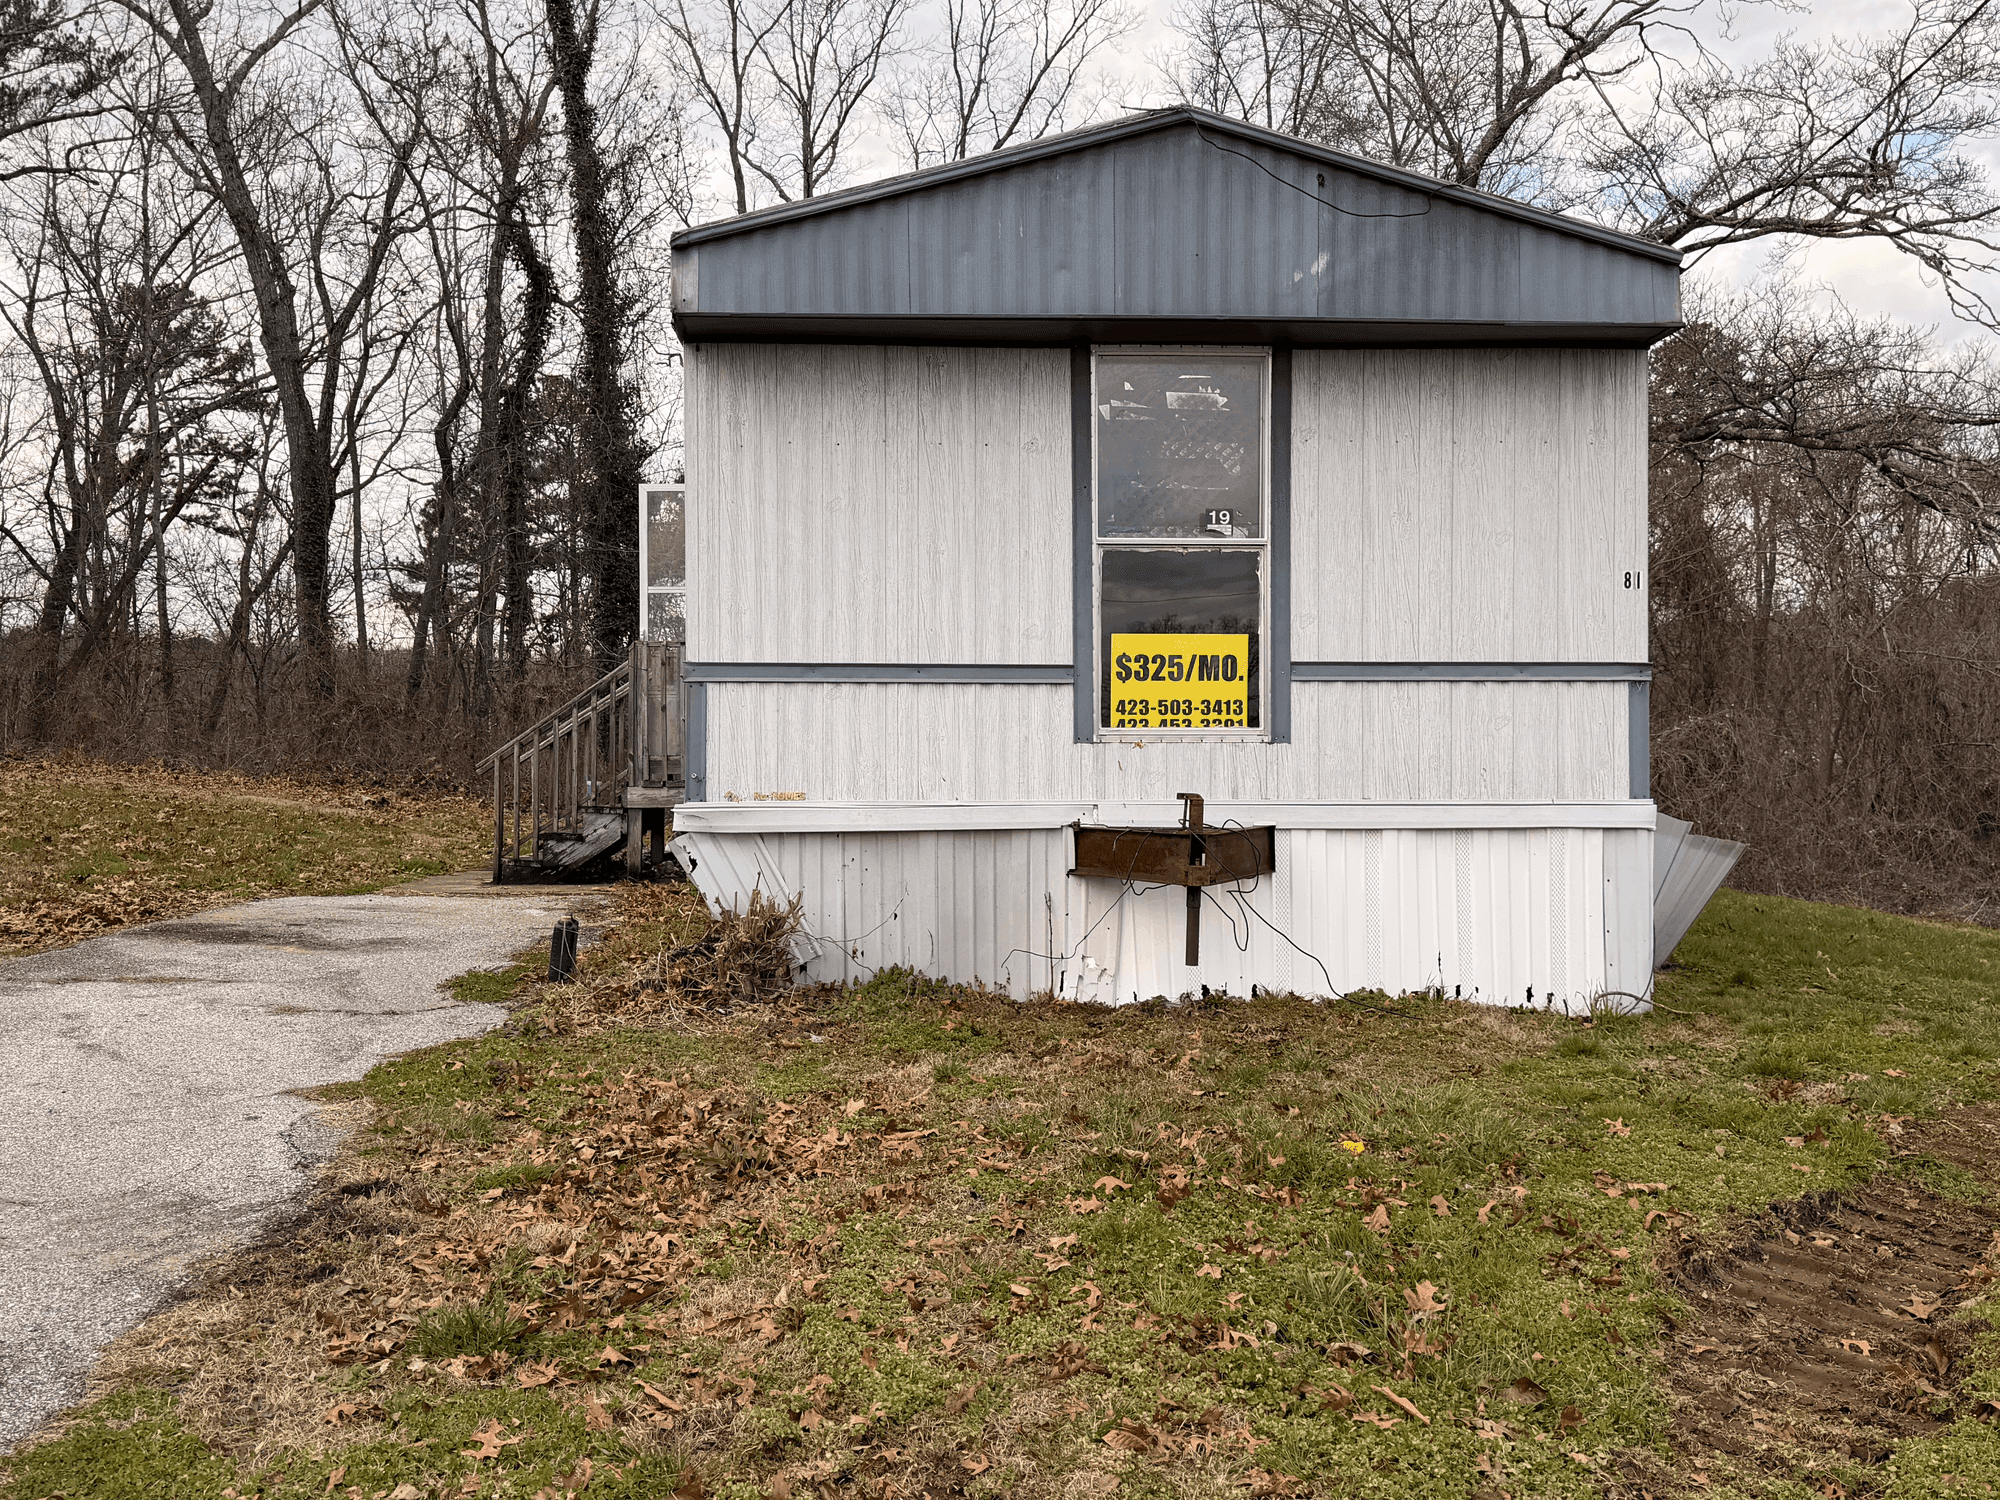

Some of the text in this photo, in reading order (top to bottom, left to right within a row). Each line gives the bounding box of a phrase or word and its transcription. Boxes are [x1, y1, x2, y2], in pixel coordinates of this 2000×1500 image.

[1208, 510, 1231, 525] 19
[1624, 571, 1641, 589] 81
[1115, 652, 1245, 683] $325/MO.
[1115, 699, 1244, 716] 423-503-3413
